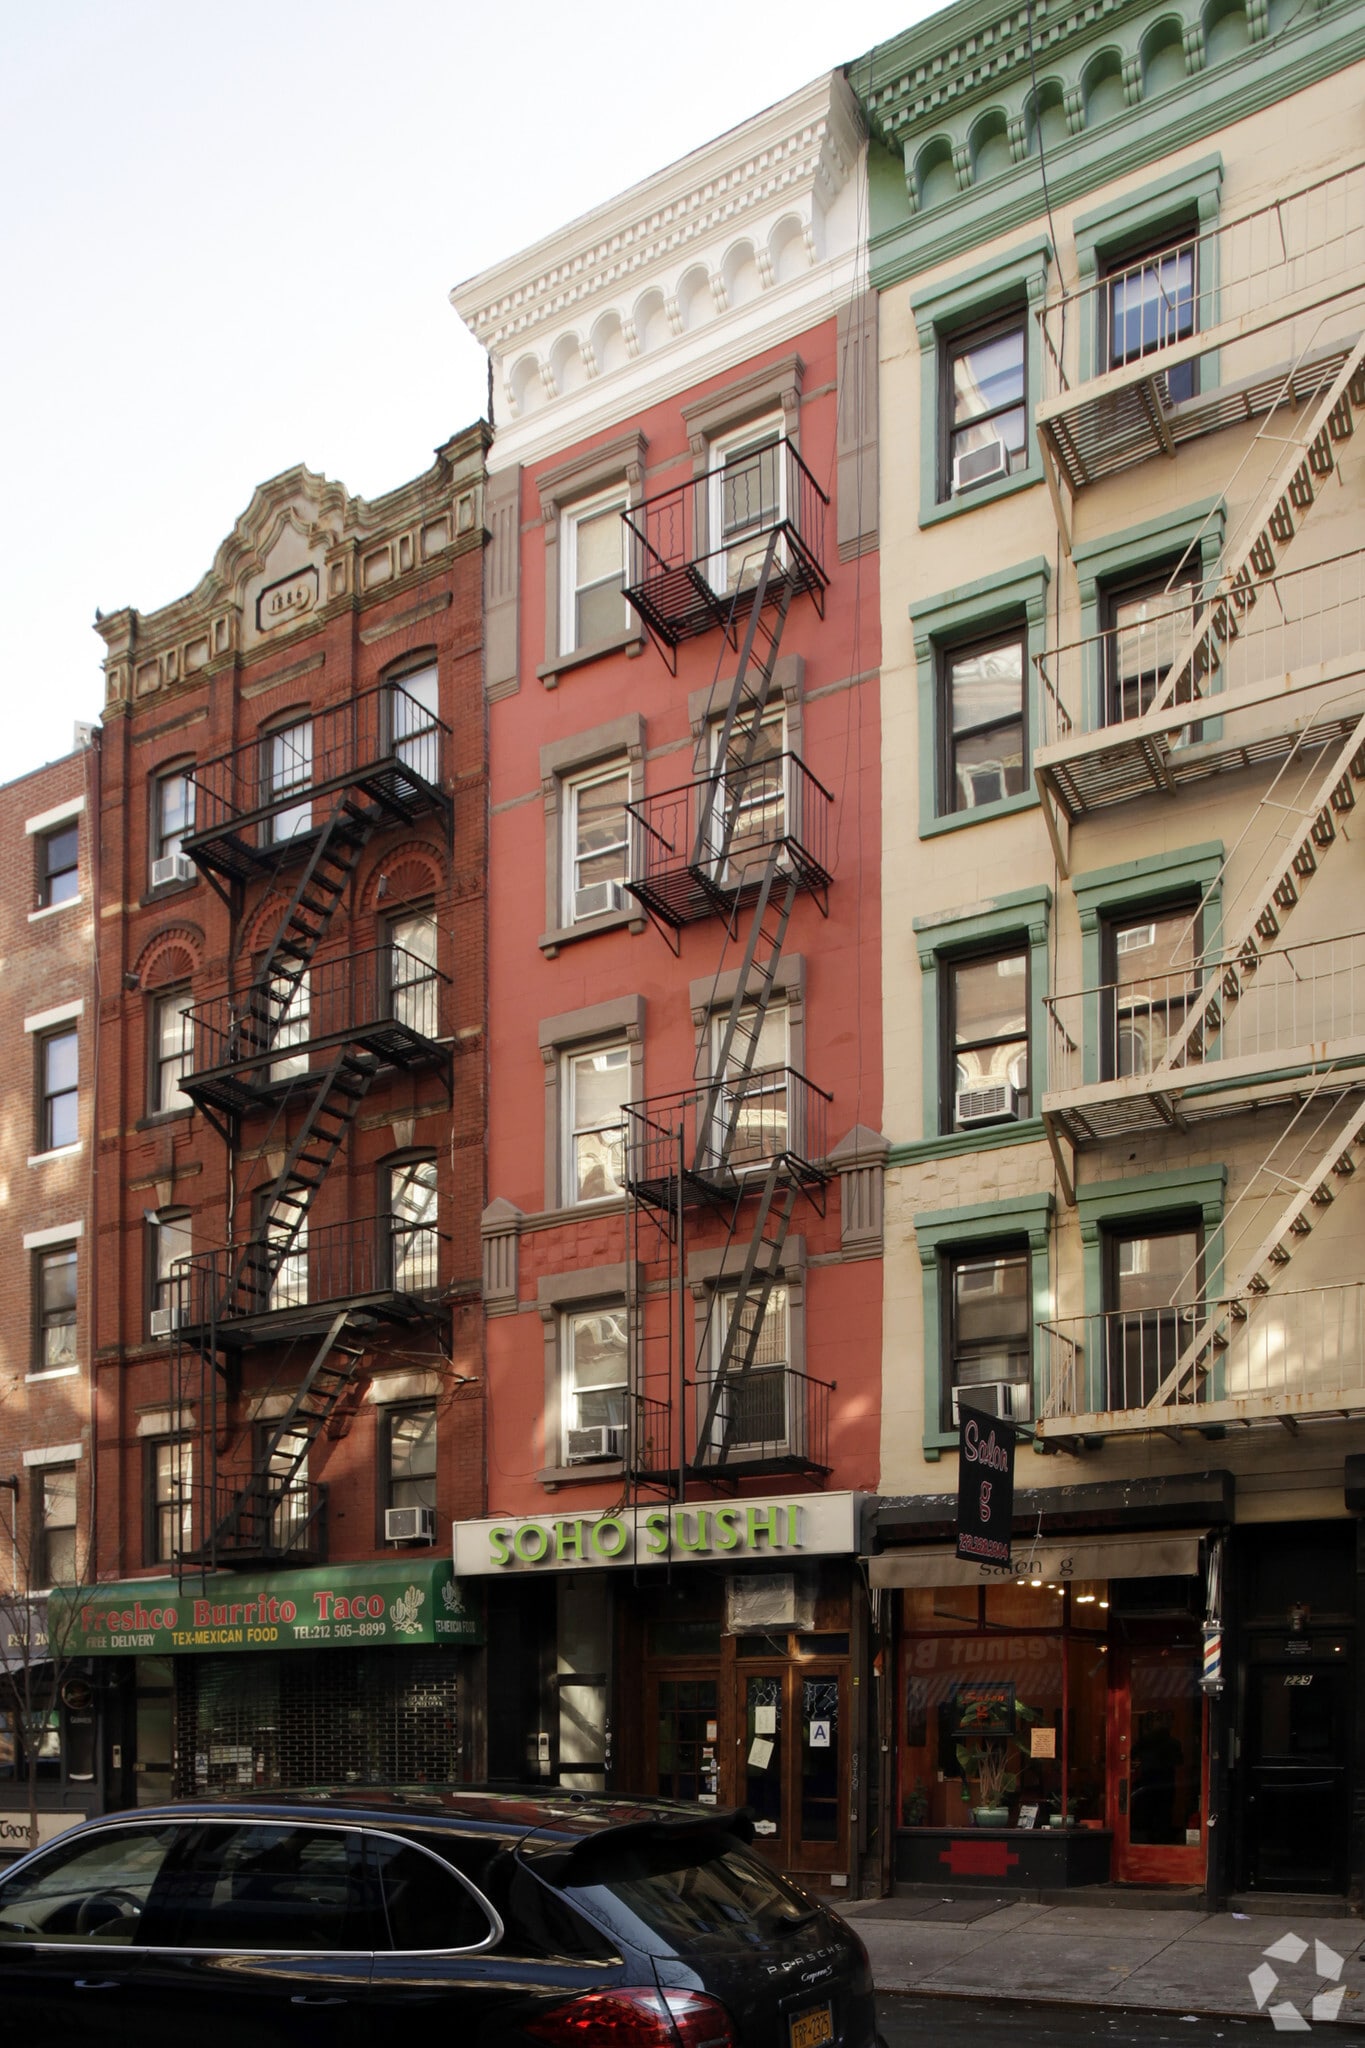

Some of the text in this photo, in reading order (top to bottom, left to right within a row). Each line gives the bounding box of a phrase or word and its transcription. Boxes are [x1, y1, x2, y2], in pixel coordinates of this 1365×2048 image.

[964, 1419, 1009, 1473] Salon
[979, 1481, 992, 1522] g
[489, 1504, 801, 1566] SOHO SUSHI
[1059, 1557, 1074, 1577] g
[80, 1590, 385, 1633] Freshco Burrito Taco
[86, 1636, 108, 1648] FREE
[111, 1634, 156, 1648] DELIVERY
[172, 1629, 243, 1646] TEX-MEXICAN
[247, 1627, 279, 1642] FOOD
[293, 1626, 331, 1640] TEL:212
[1286, 1674, 1312, 1686] 229
[814, 1724, 827, 1740] A
[766, 1943, 843, 1975] PORSCHE
